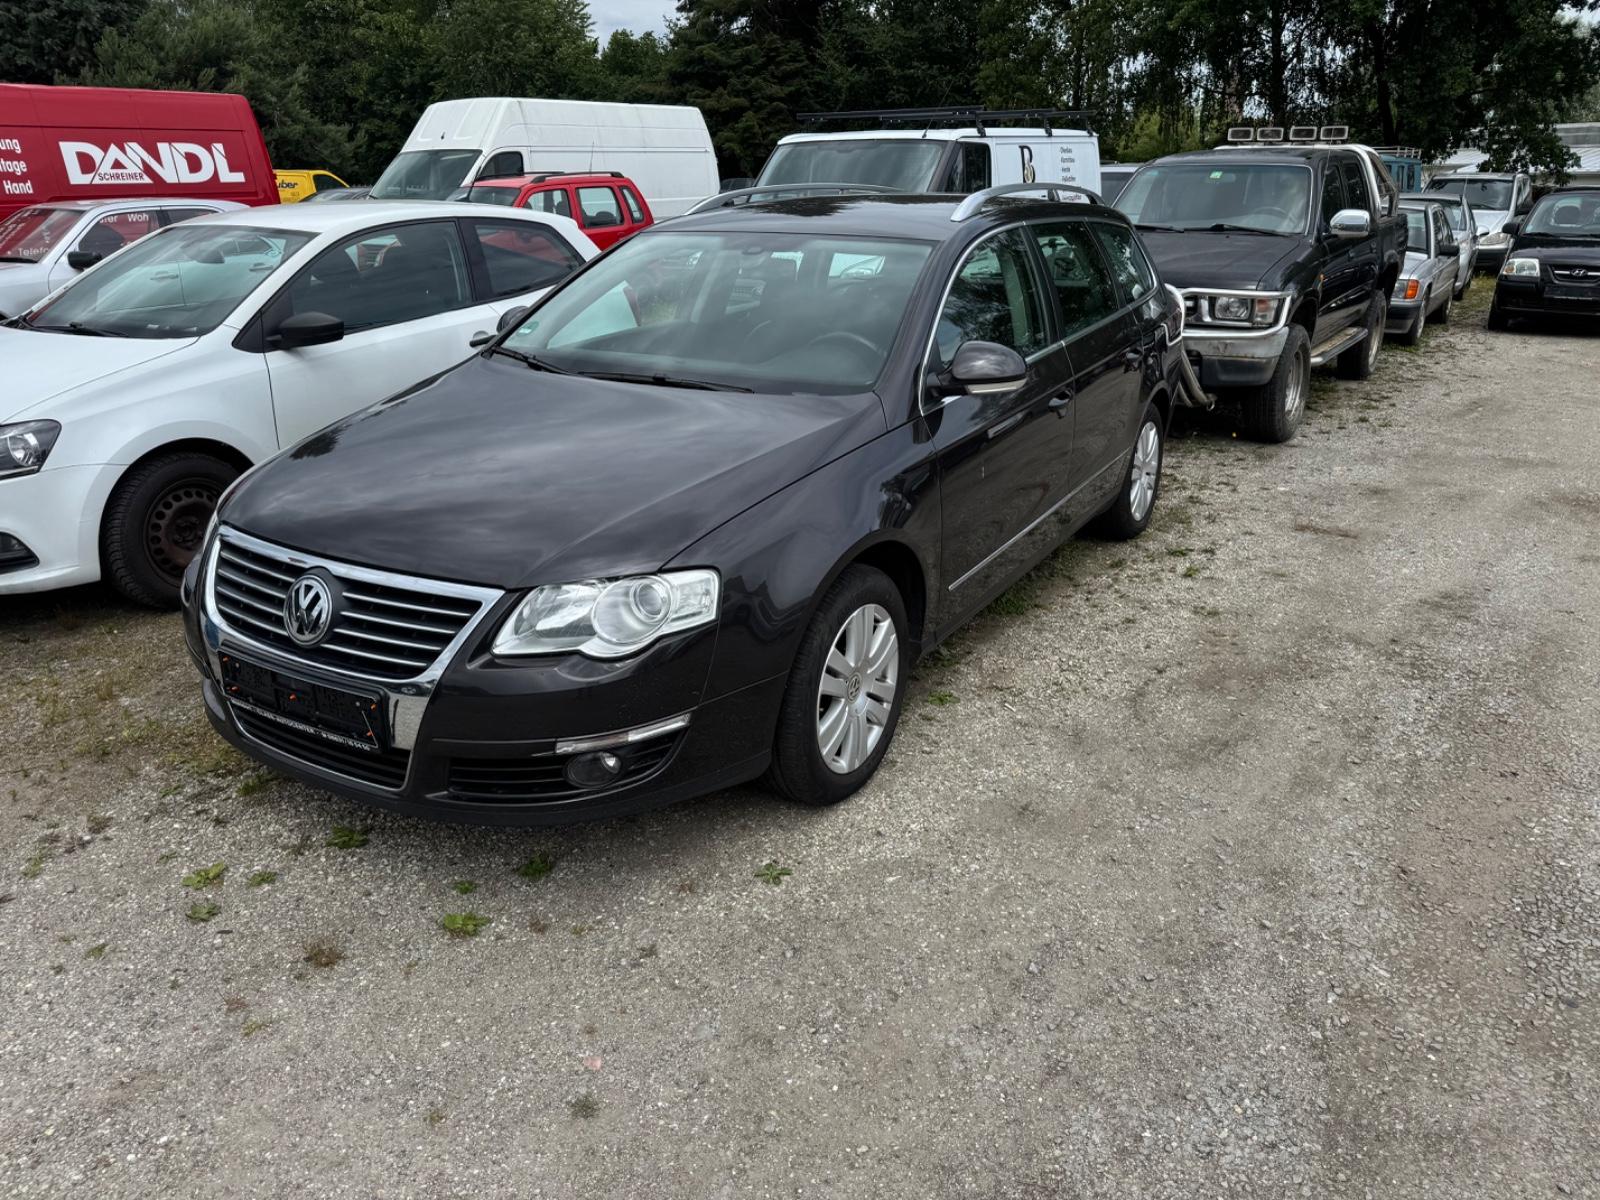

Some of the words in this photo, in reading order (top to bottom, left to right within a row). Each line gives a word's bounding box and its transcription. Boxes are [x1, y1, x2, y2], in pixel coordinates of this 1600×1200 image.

[0, 158, 27, 176] tage
[59, 141, 246, 185] DANDL
[97, 171, 145, 182] SCHREINER
[3, 179, 34, 195] Hand
